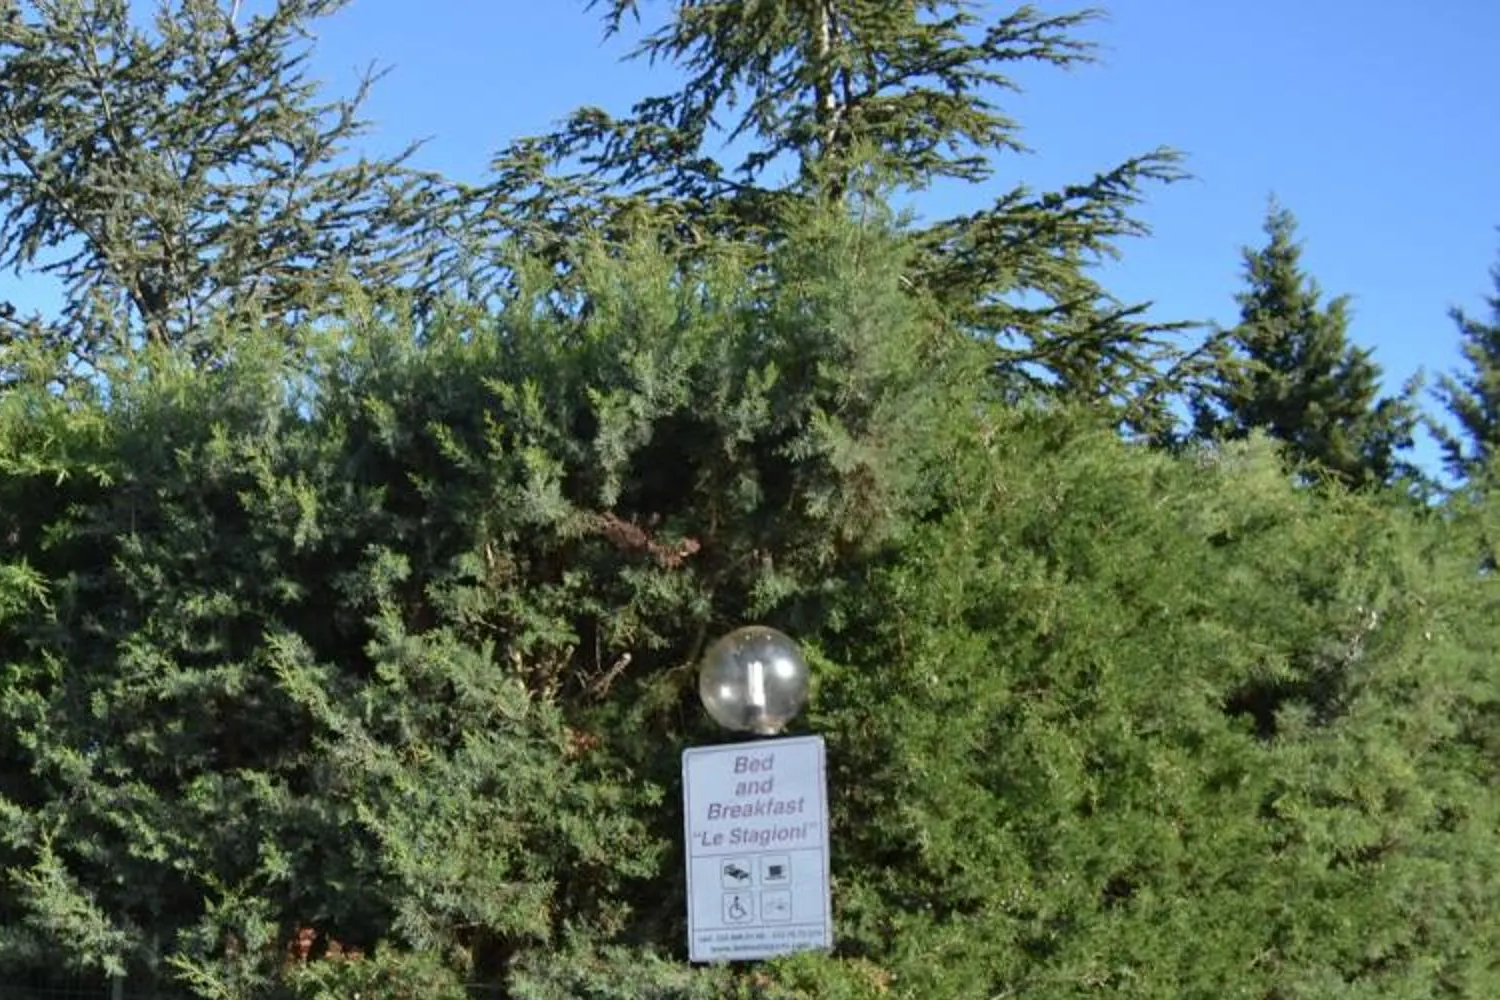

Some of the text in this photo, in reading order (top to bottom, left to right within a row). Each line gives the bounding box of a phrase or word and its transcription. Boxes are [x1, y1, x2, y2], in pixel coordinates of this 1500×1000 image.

[734, 754, 774, 774] Bed
[735, 777, 773, 796] and
[707, 797, 804, 820] Breakfast
